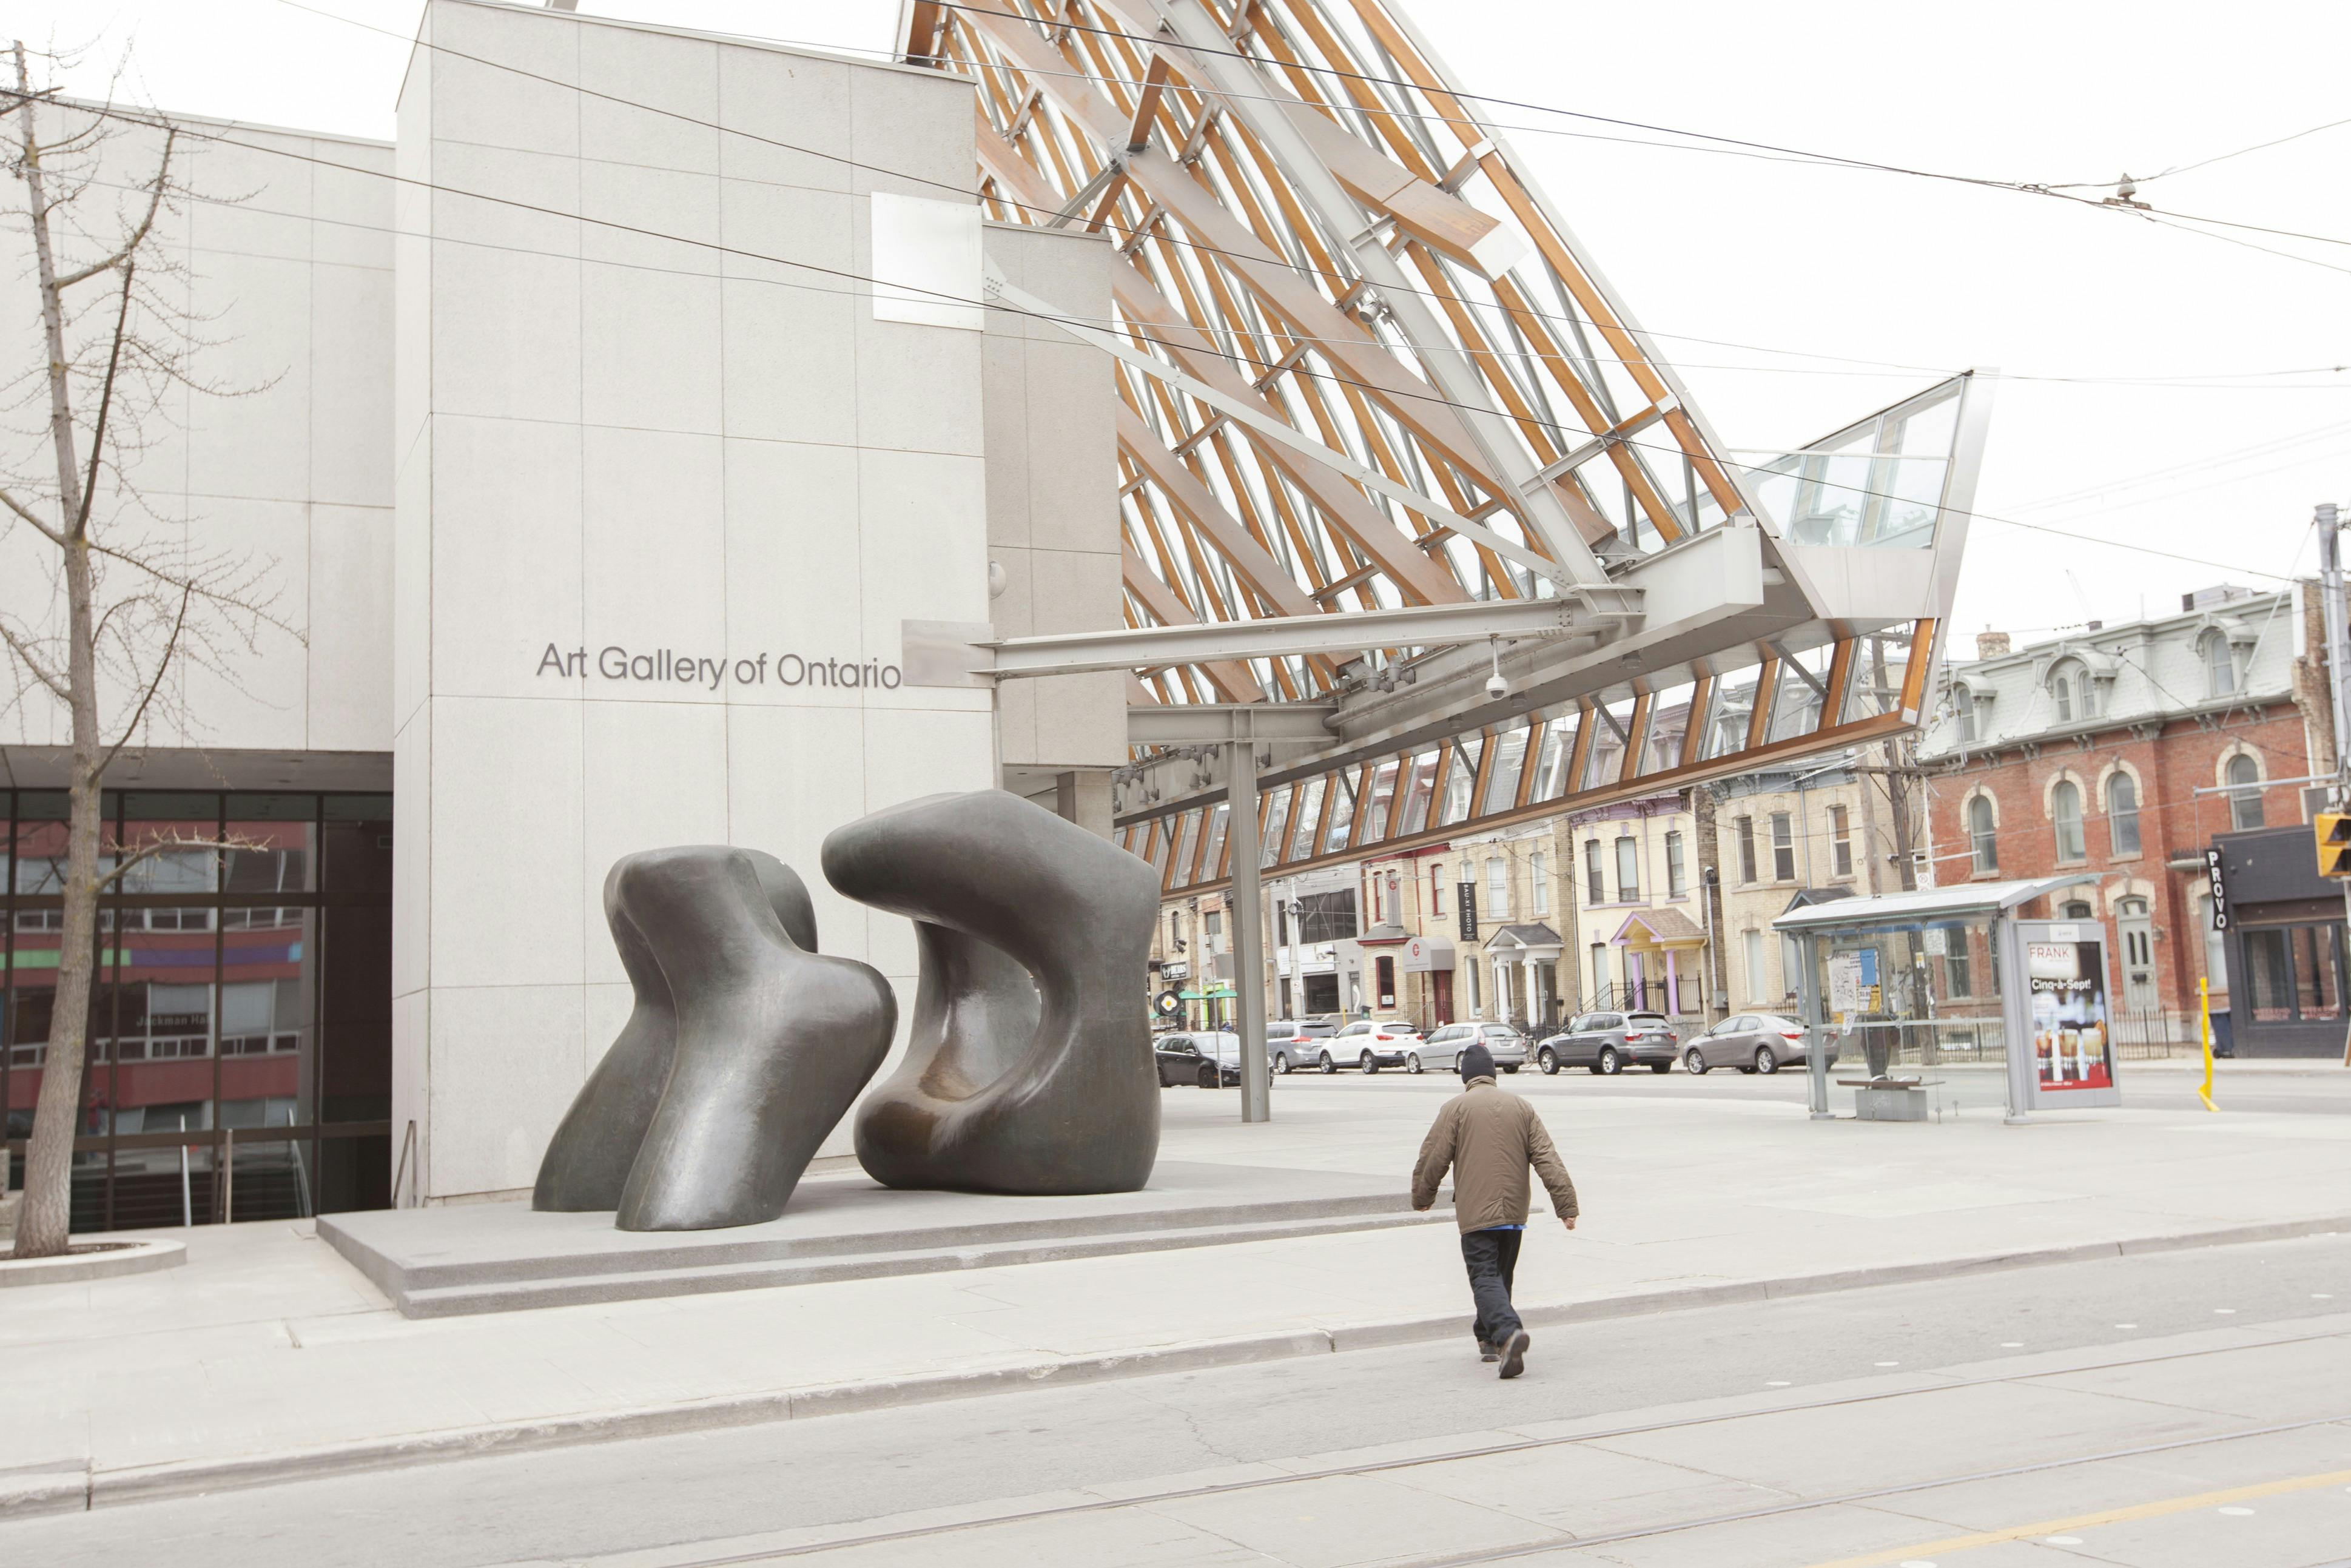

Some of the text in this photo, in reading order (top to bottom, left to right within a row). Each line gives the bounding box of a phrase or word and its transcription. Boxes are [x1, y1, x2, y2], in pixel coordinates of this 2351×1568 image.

[536, 642, 901, 690] Art Gallery of Ontario
[2208, 851, 2227, 929] PROVO
[2030, 947, 2069, 958] FRANK
